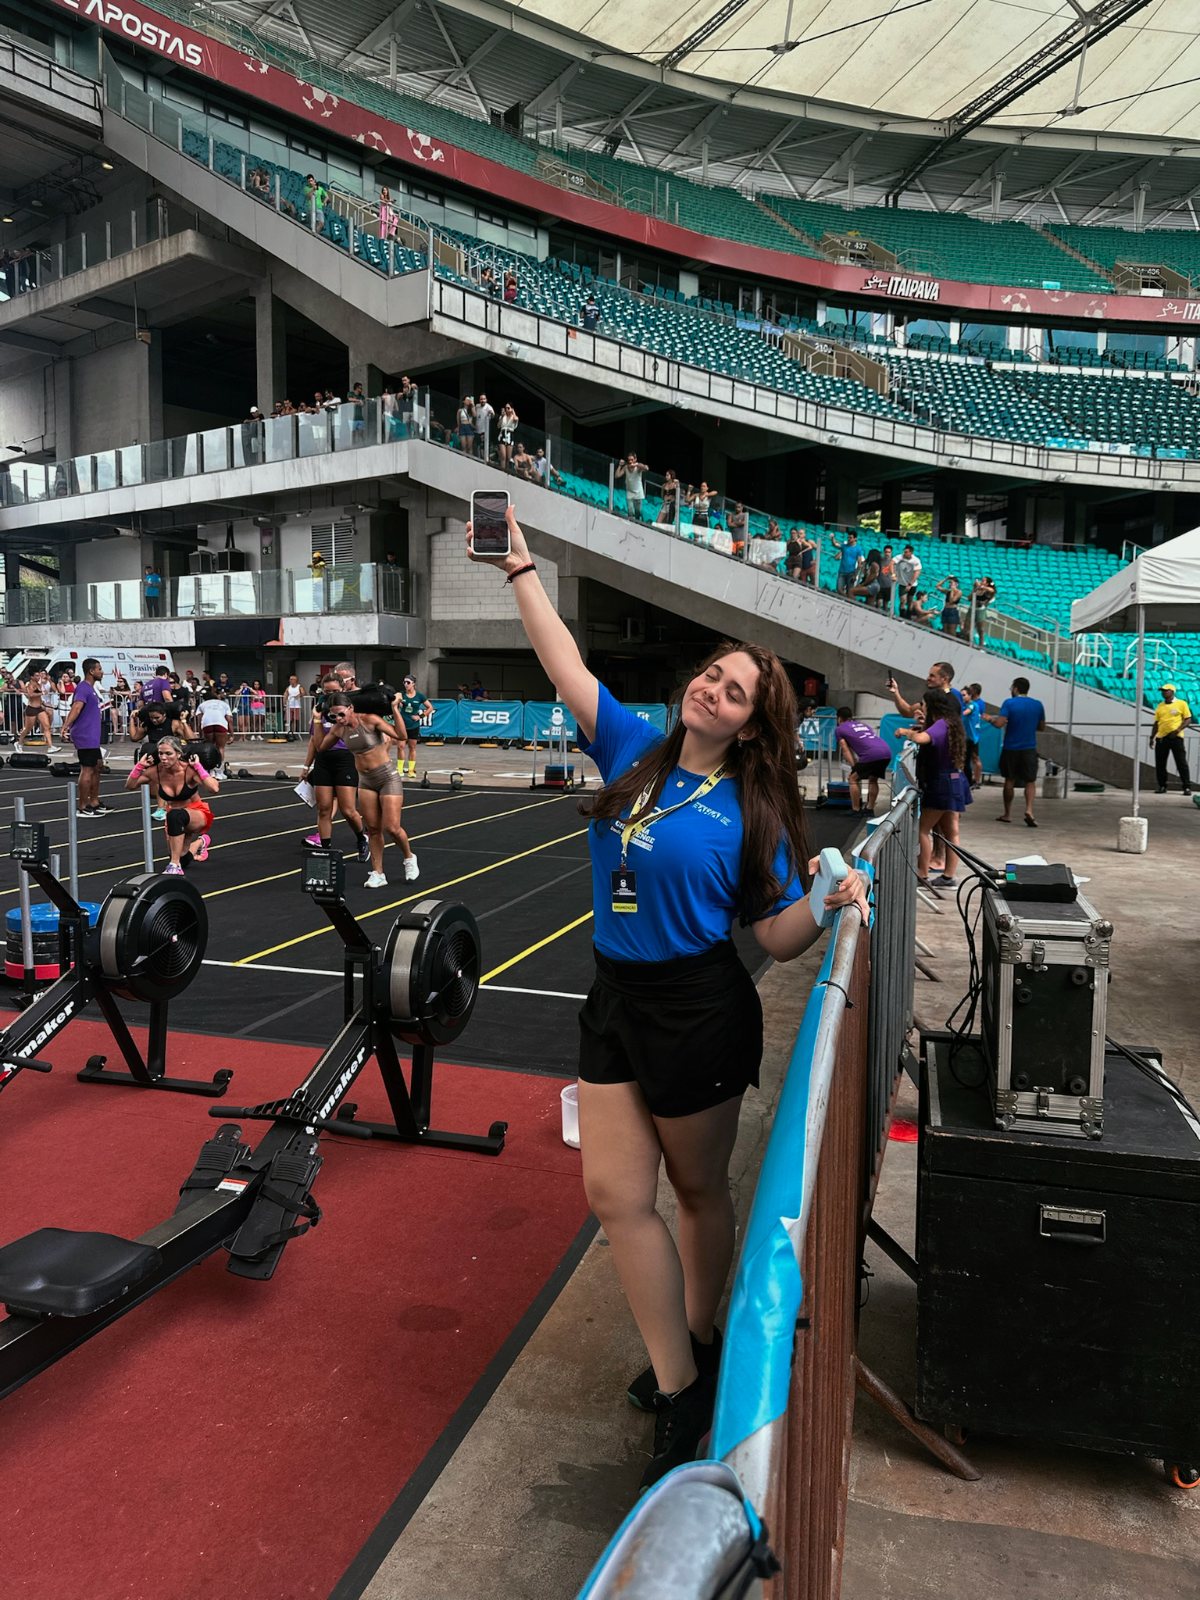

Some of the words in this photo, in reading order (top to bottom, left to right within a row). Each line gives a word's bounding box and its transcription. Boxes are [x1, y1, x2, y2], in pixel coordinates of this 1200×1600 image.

[85, 0, 202, 66] APOSTAS
[886, 275, 940, 301] ITAIPAVA
[470, 710, 510, 725] 2GB
